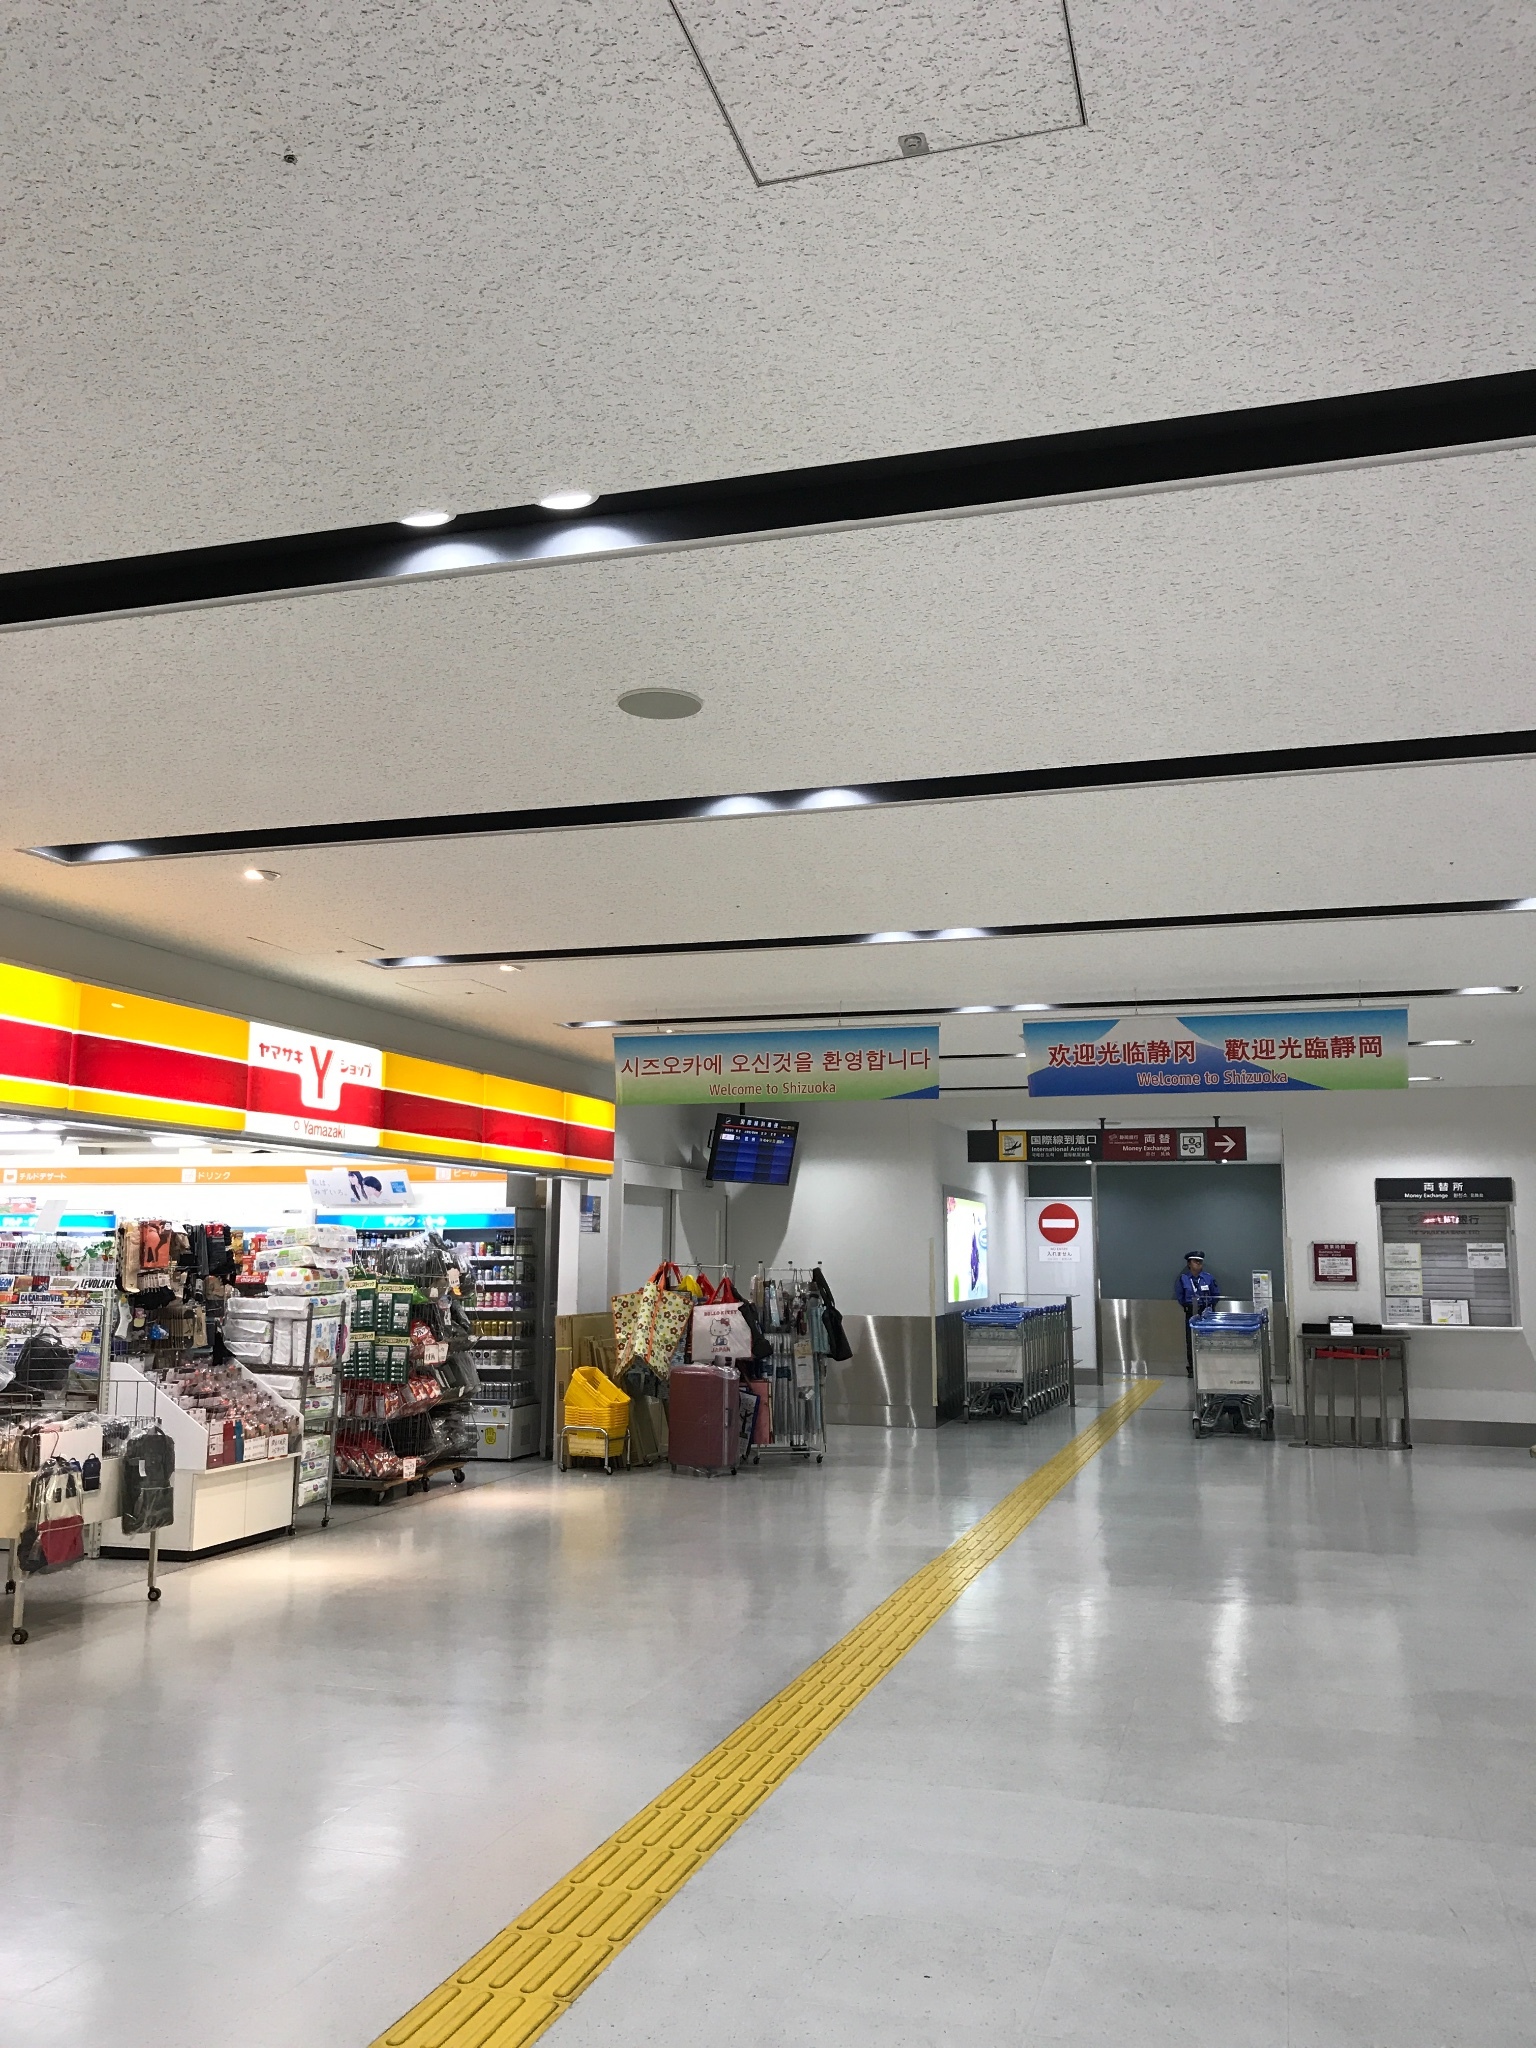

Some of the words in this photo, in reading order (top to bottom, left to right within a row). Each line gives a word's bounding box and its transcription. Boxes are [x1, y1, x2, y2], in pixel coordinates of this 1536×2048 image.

[1048, 1040, 1196, 1067] 欢迎光临静冈
[620, 1054, 723, 1077] 시즈오카에
[730, 1051, 815, 1075] 오신것을
[822, 1047, 931, 1072] 환영합니다
[310, 1046, 334, 1099] Y
[1137, 1071, 1200, 1086] Welcome
[1204, 1070, 1220, 1085] to
[1223, 1068, 1288, 1084] Shizuoka
[709, 1082, 762, 1097] Welcome
[766, 1083, 779, 1096] to
[782, 1081, 836, 1095] Shizuoka
[303, 1120, 346, 1138] Yamazaki
[1030, 1134, 1097, 1145] 国際線到着口
[19, 1172, 67, 1181] チルドデザート
[198, 1171, 231, 1181] ドリンク
[1423, 1182, 1464, 1192] 両替所
[1423, 1192, 1449, 1200] Exchange
